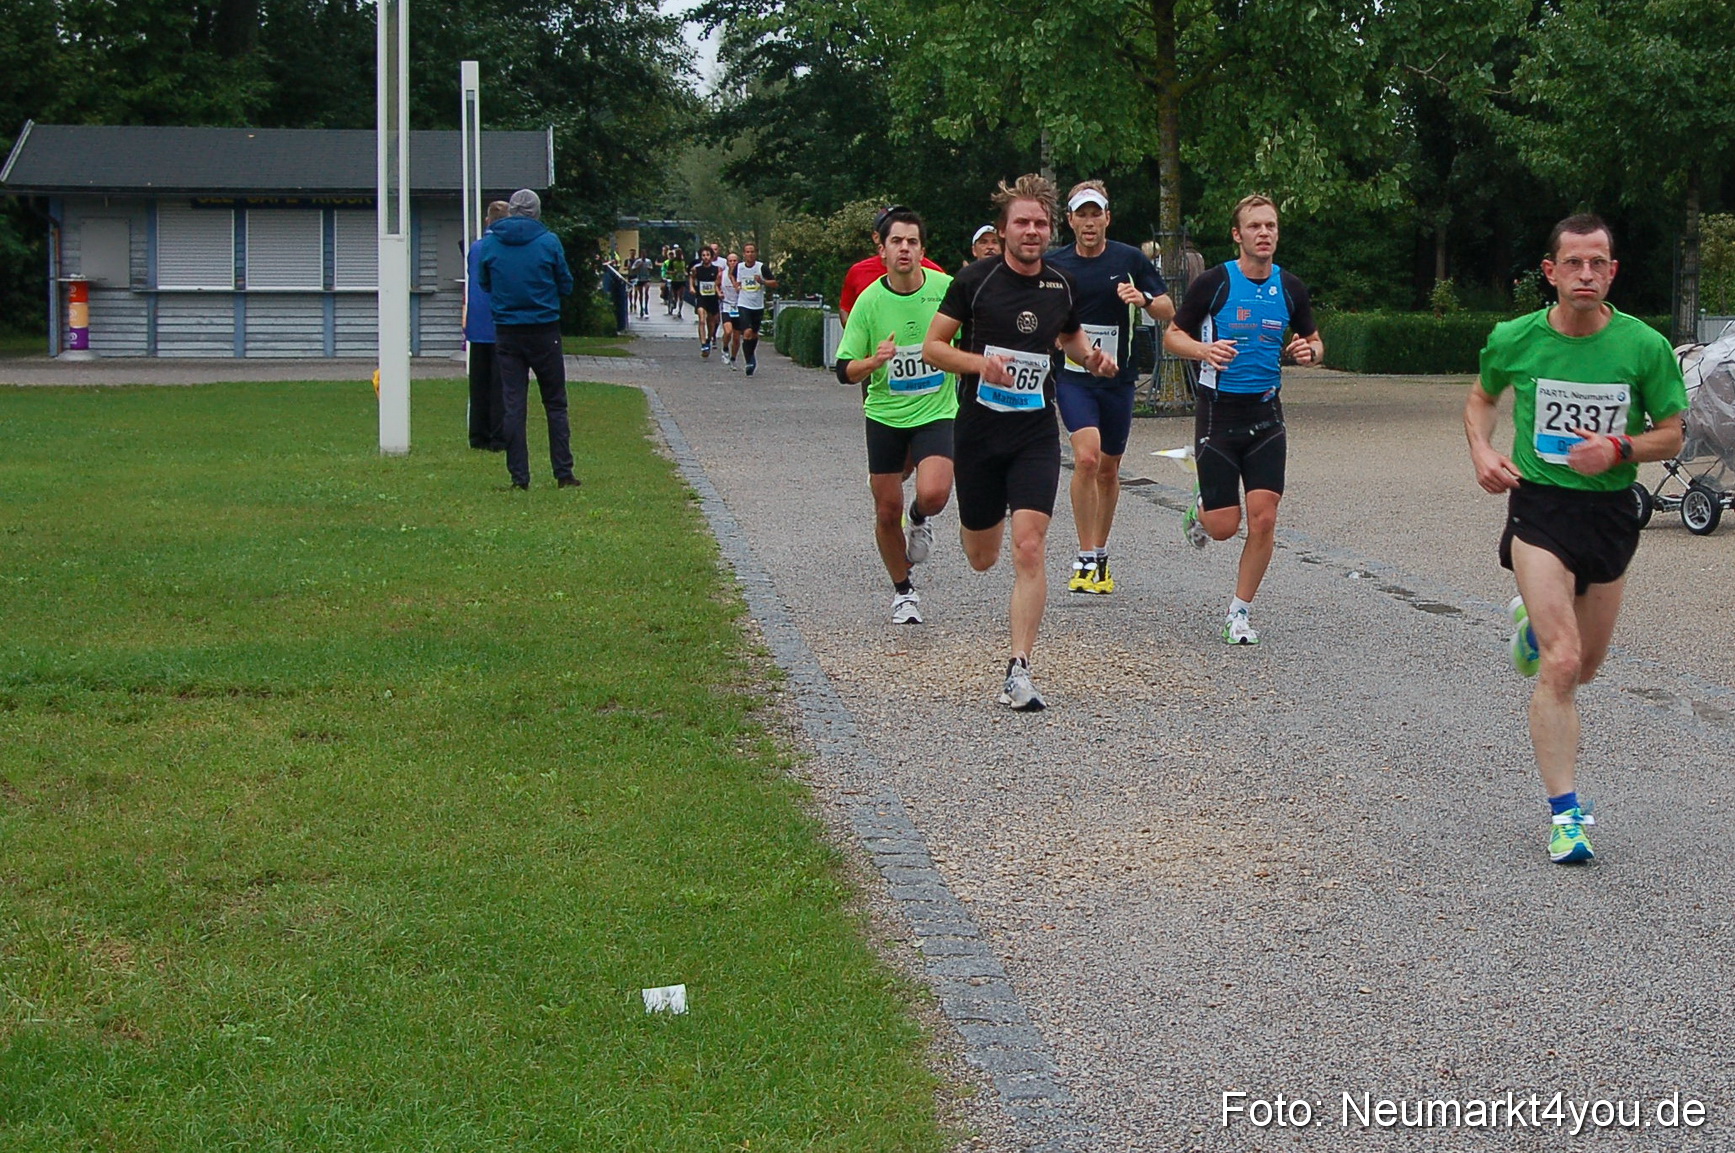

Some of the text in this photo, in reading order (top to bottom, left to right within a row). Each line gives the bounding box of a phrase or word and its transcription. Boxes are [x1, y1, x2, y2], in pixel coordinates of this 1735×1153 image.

[1540, 387, 1615, 401] PARTL Neumarkt
[1546, 401, 1620, 434] 2337
